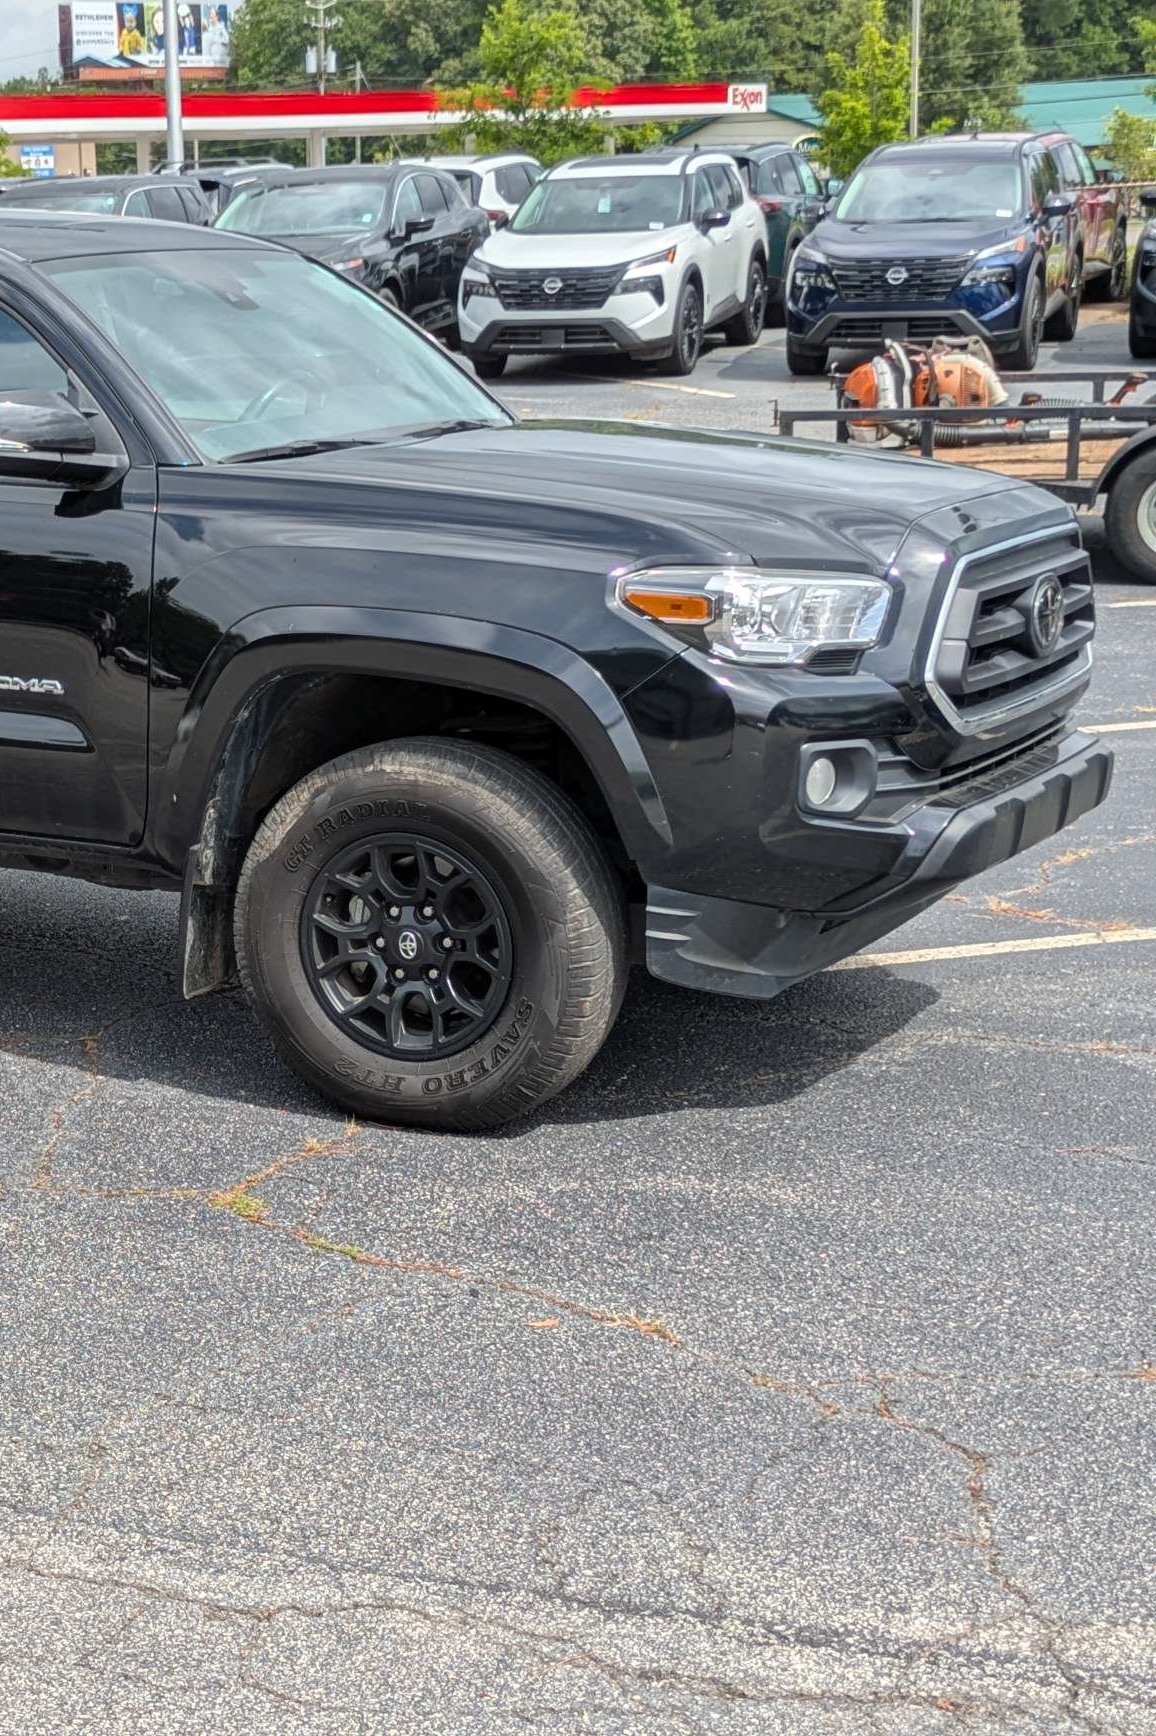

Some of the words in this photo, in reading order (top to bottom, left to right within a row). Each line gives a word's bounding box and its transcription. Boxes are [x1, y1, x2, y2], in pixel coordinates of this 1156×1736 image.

[731, 87, 763, 111] Exxon
[284, 832, 315, 873] GT
[315, 799, 432, 840] RADIAL
[421, 996, 535, 1096] SAVERO
